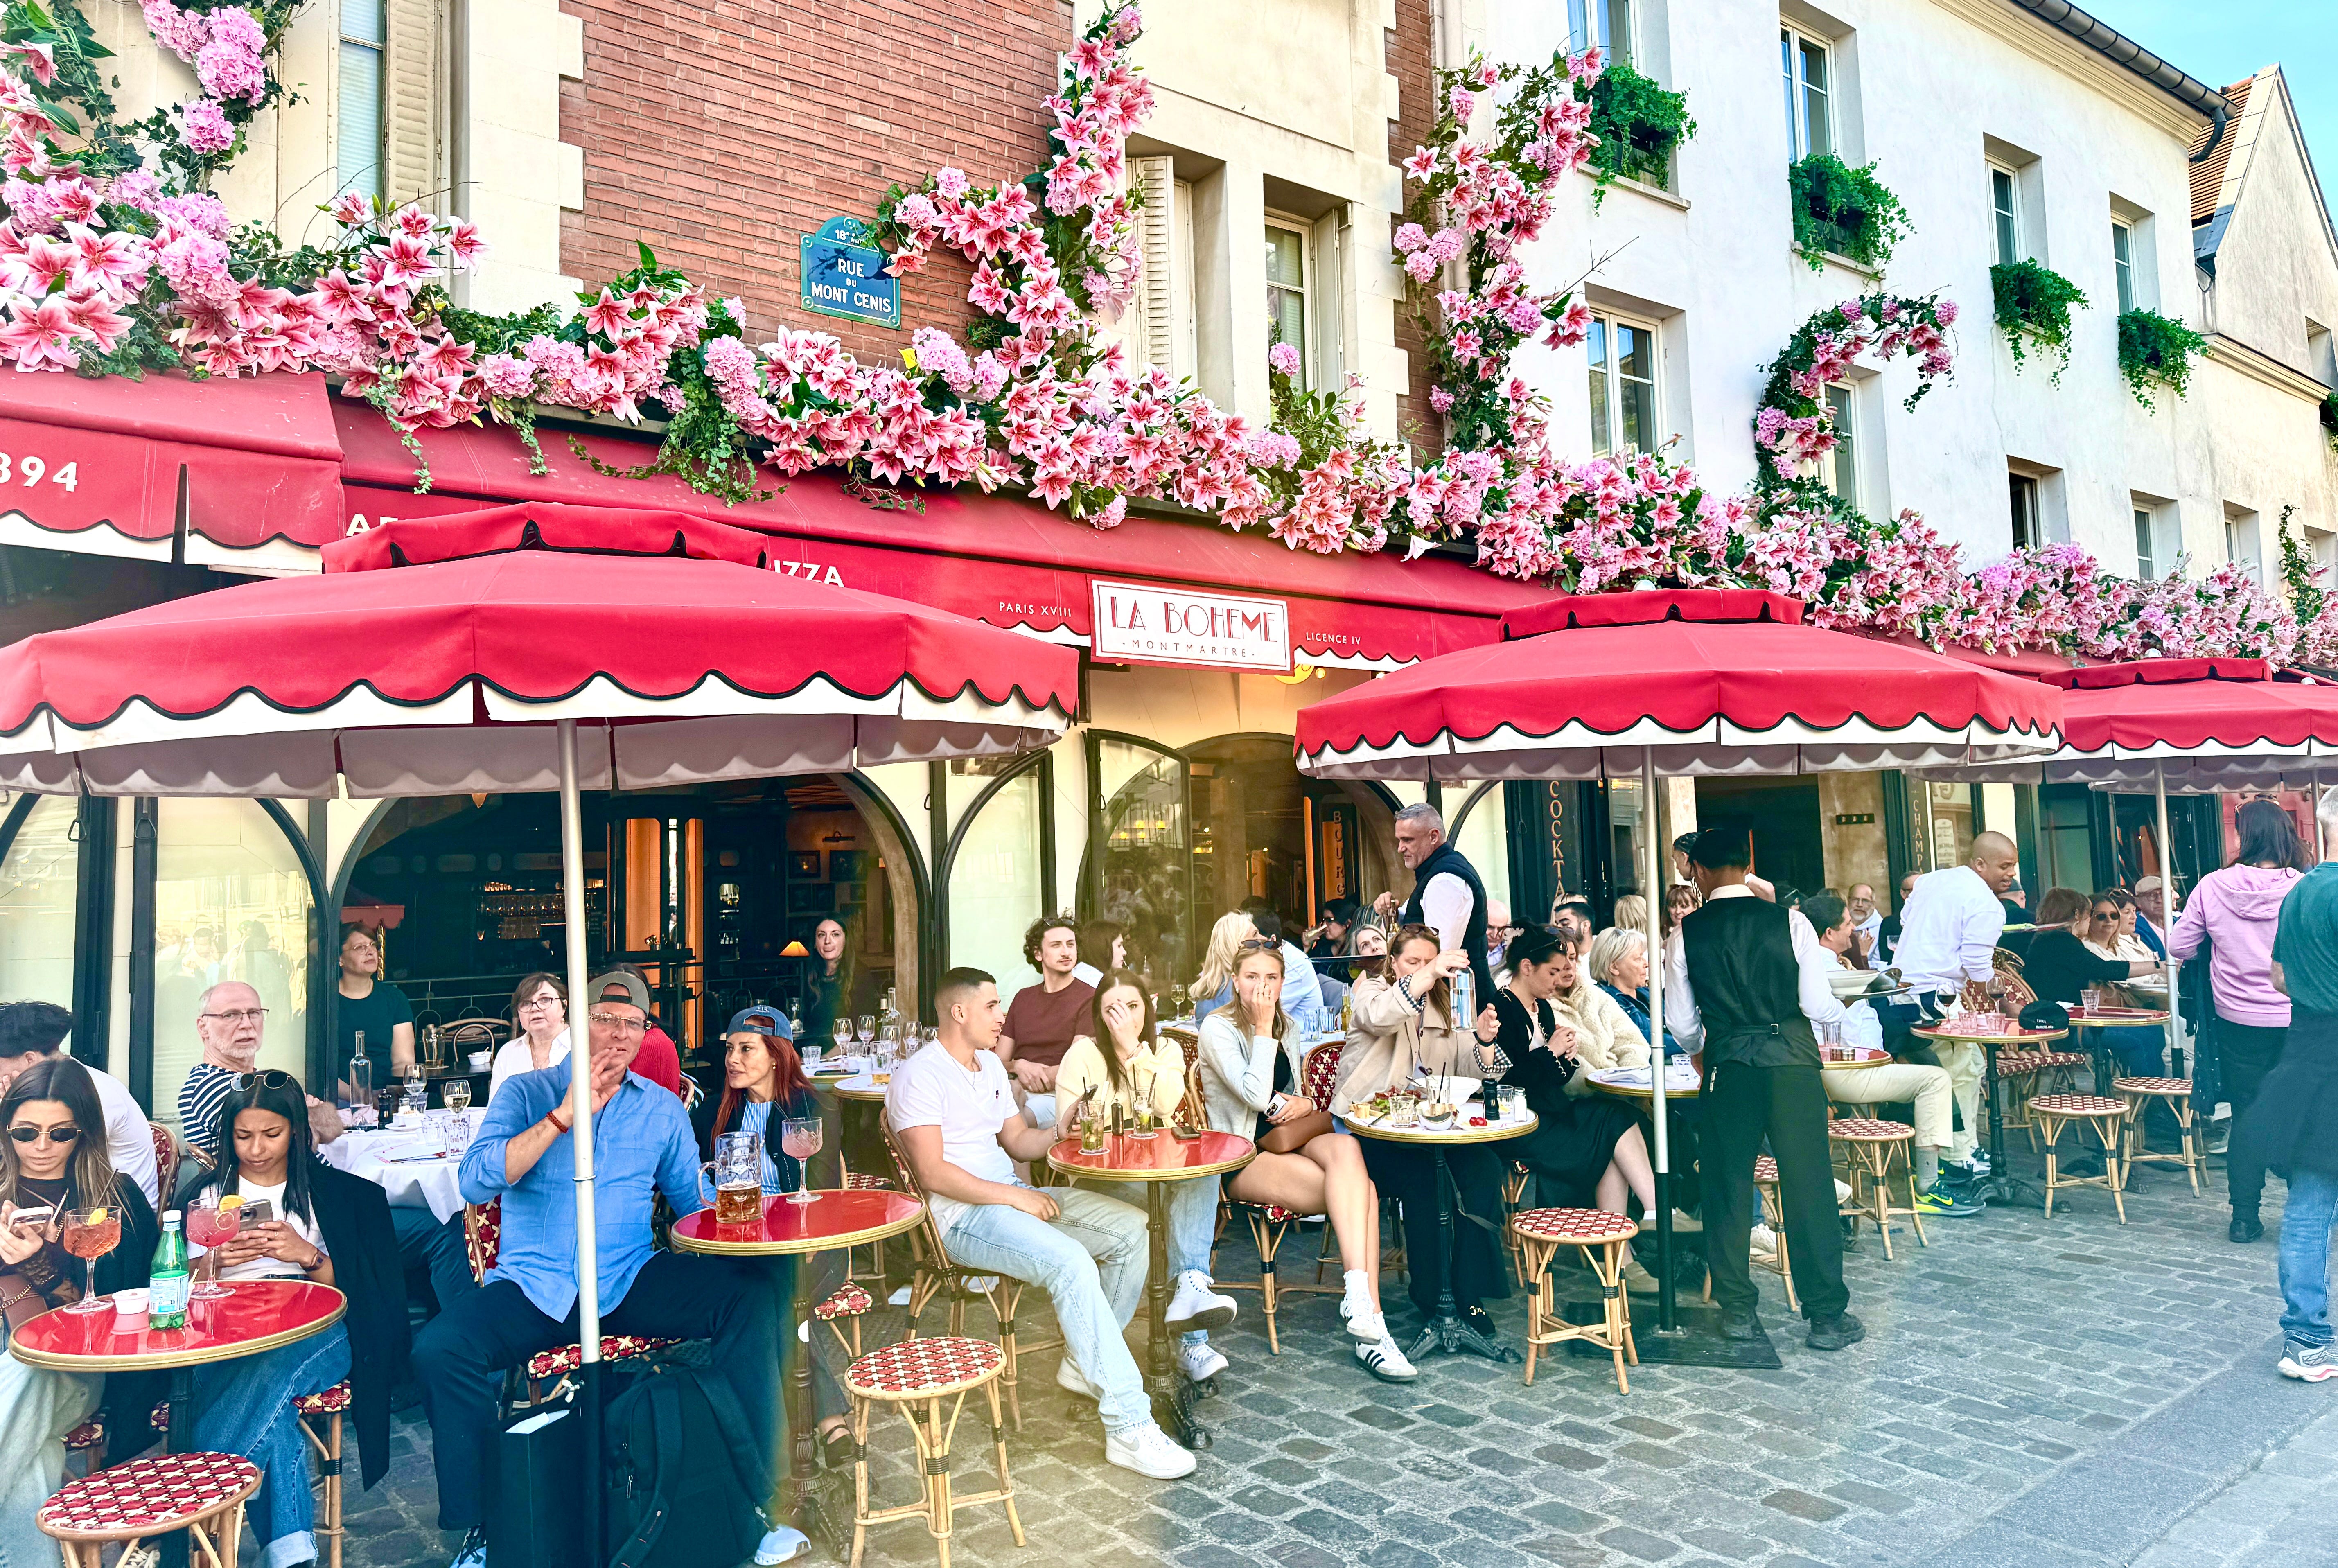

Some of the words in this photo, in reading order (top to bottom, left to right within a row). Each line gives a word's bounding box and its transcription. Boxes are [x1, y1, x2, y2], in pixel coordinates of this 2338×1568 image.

[838, 258, 864, 278] RUE
[846, 278, 857, 287] DU
[811, 282, 848, 303] MONT
[854, 292, 891, 313] CENIS
[769, 560, 844, 587] IZZA
[999, 602, 1034, 614] PARIS
[1041, 606, 1071, 618] XVIII
[1110, 596, 1146, 630] LA
[1164, 602, 1277, 642] BOHEME
[1306, 632, 1347, 644] LICENCE
[1352, 636, 1361, 645] IV
